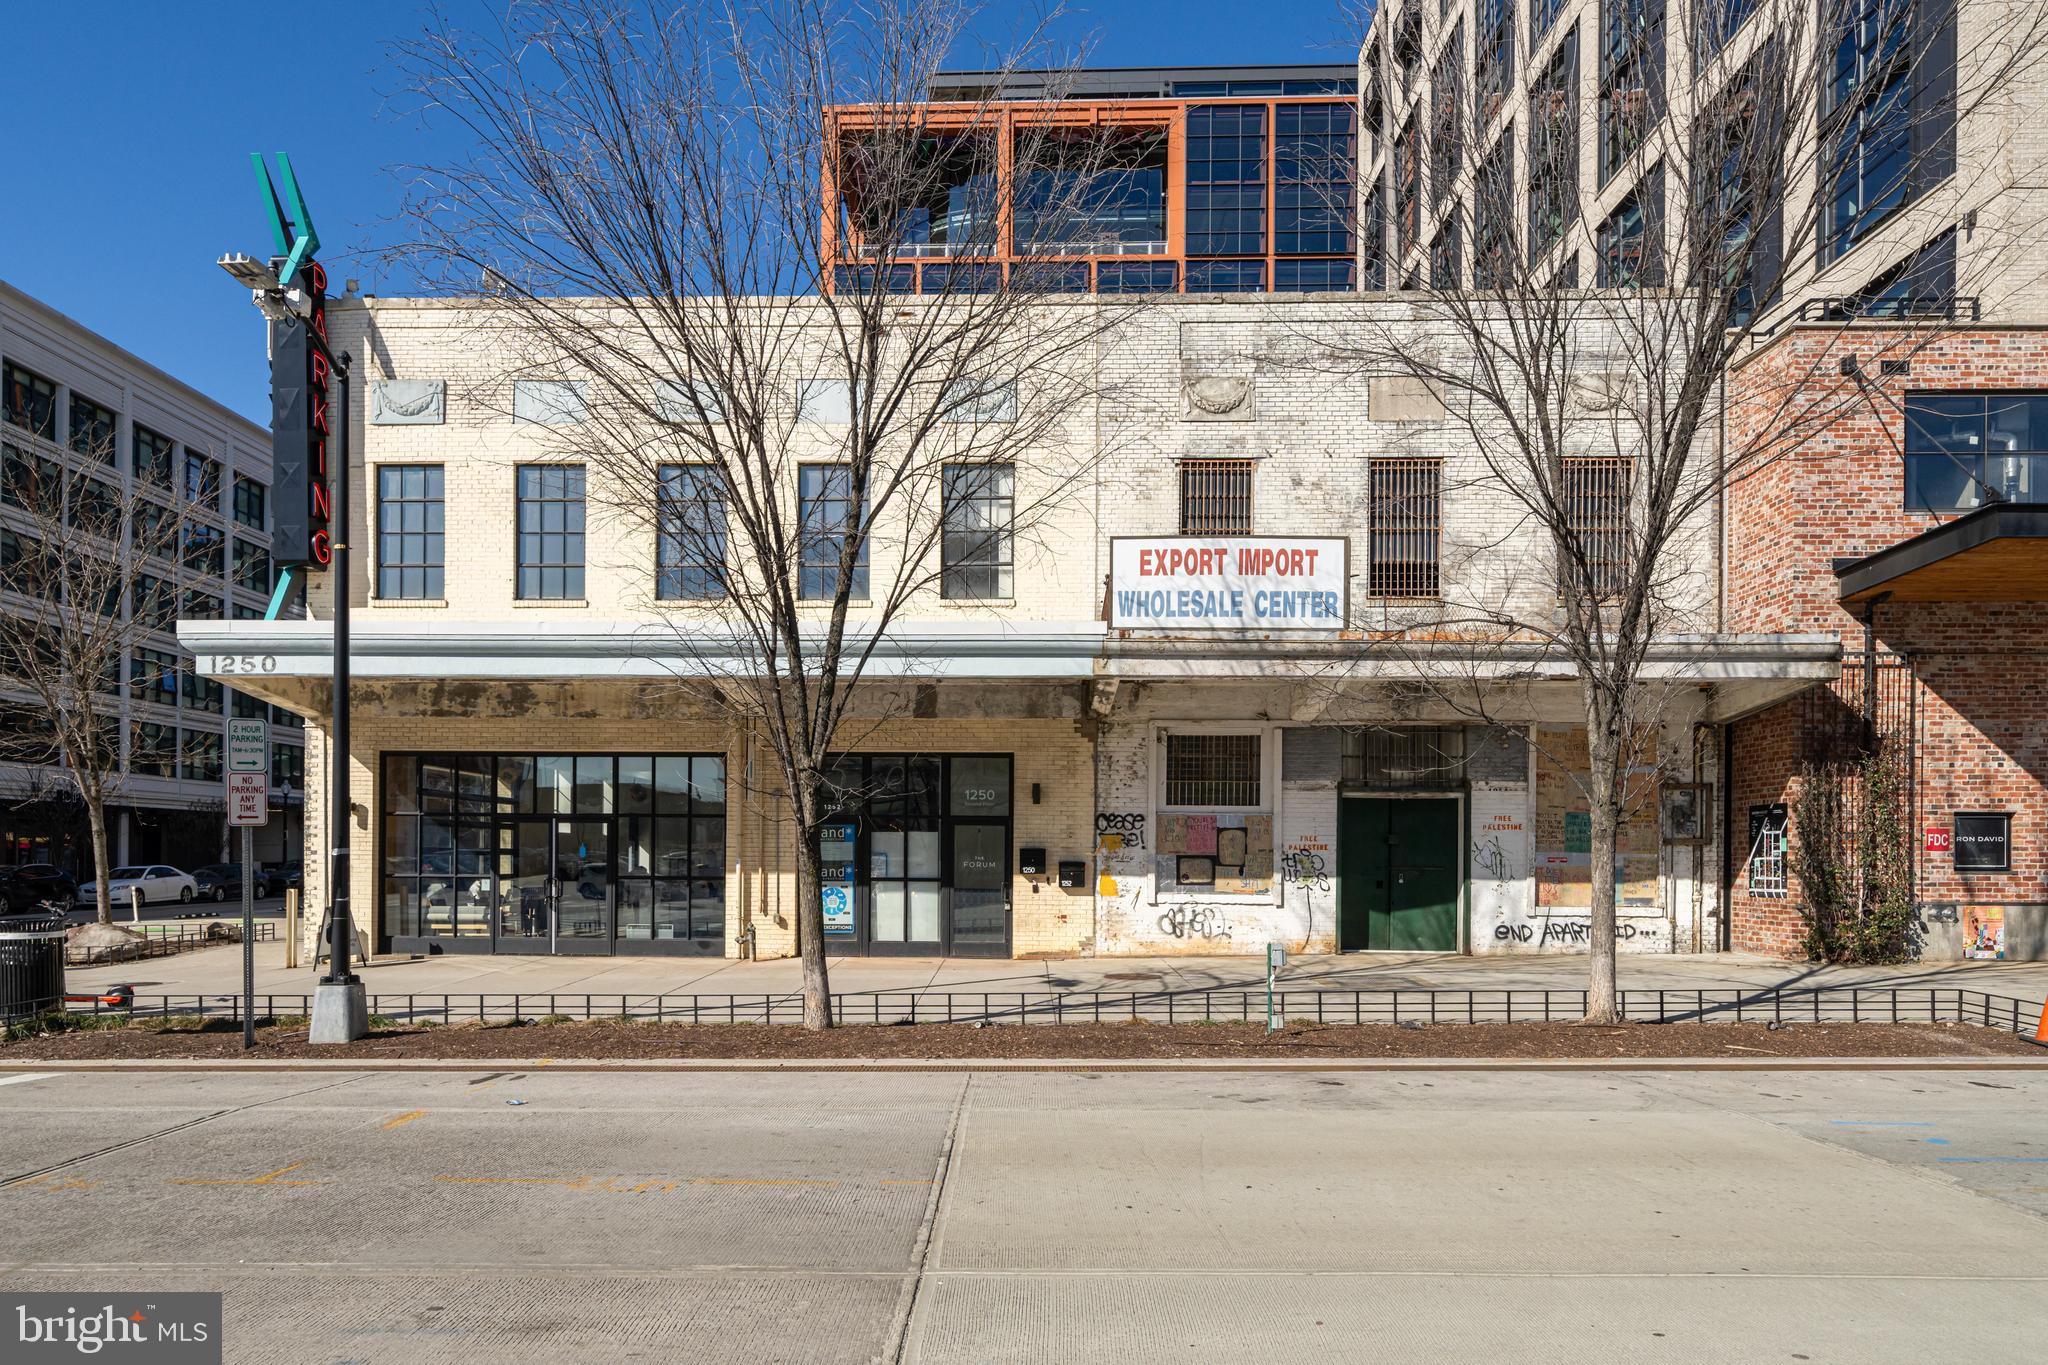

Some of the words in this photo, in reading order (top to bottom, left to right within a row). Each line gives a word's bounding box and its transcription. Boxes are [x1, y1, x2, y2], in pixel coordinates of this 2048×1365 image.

[311, 262, 332, 566] PARKING
[1139, 548, 1228, 576] EXPORT
[1238, 548, 1319, 576] IMPORT
[1117, 590, 1244, 618] WHOLESALE
[1254, 590, 1339, 618] CENTER
[209, 655, 278, 674] 1250
[233, 725, 239, 733] 2
[241, 725, 261, 733] HOUR
[231, 735, 264, 743] PARKING
[242, 776, 253, 784] NO
[231, 786, 264, 794] PARKING
[965, 789, 995, 801] 1250
[240, 795, 256, 803] ANY
[239, 804, 257, 812] TIME
[821, 828, 845, 838] and
[1927, 834, 1949, 847] FDC
[821, 867, 845, 877] and
